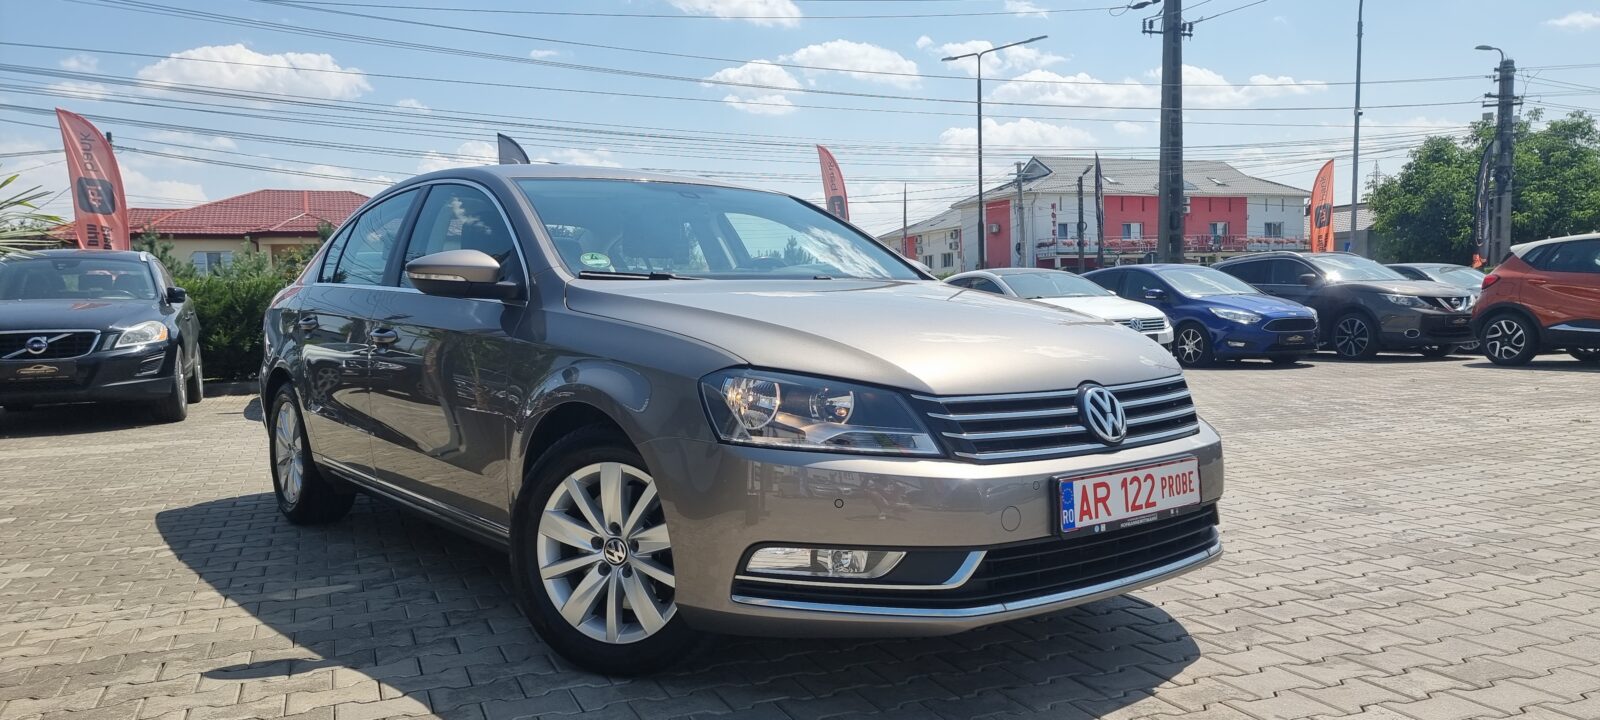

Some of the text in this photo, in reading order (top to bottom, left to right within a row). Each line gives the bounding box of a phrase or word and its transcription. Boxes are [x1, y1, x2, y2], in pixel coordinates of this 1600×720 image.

[1078, 470, 1195, 523] AR 122 PROBE
[1062, 508, 1075, 525] RO
